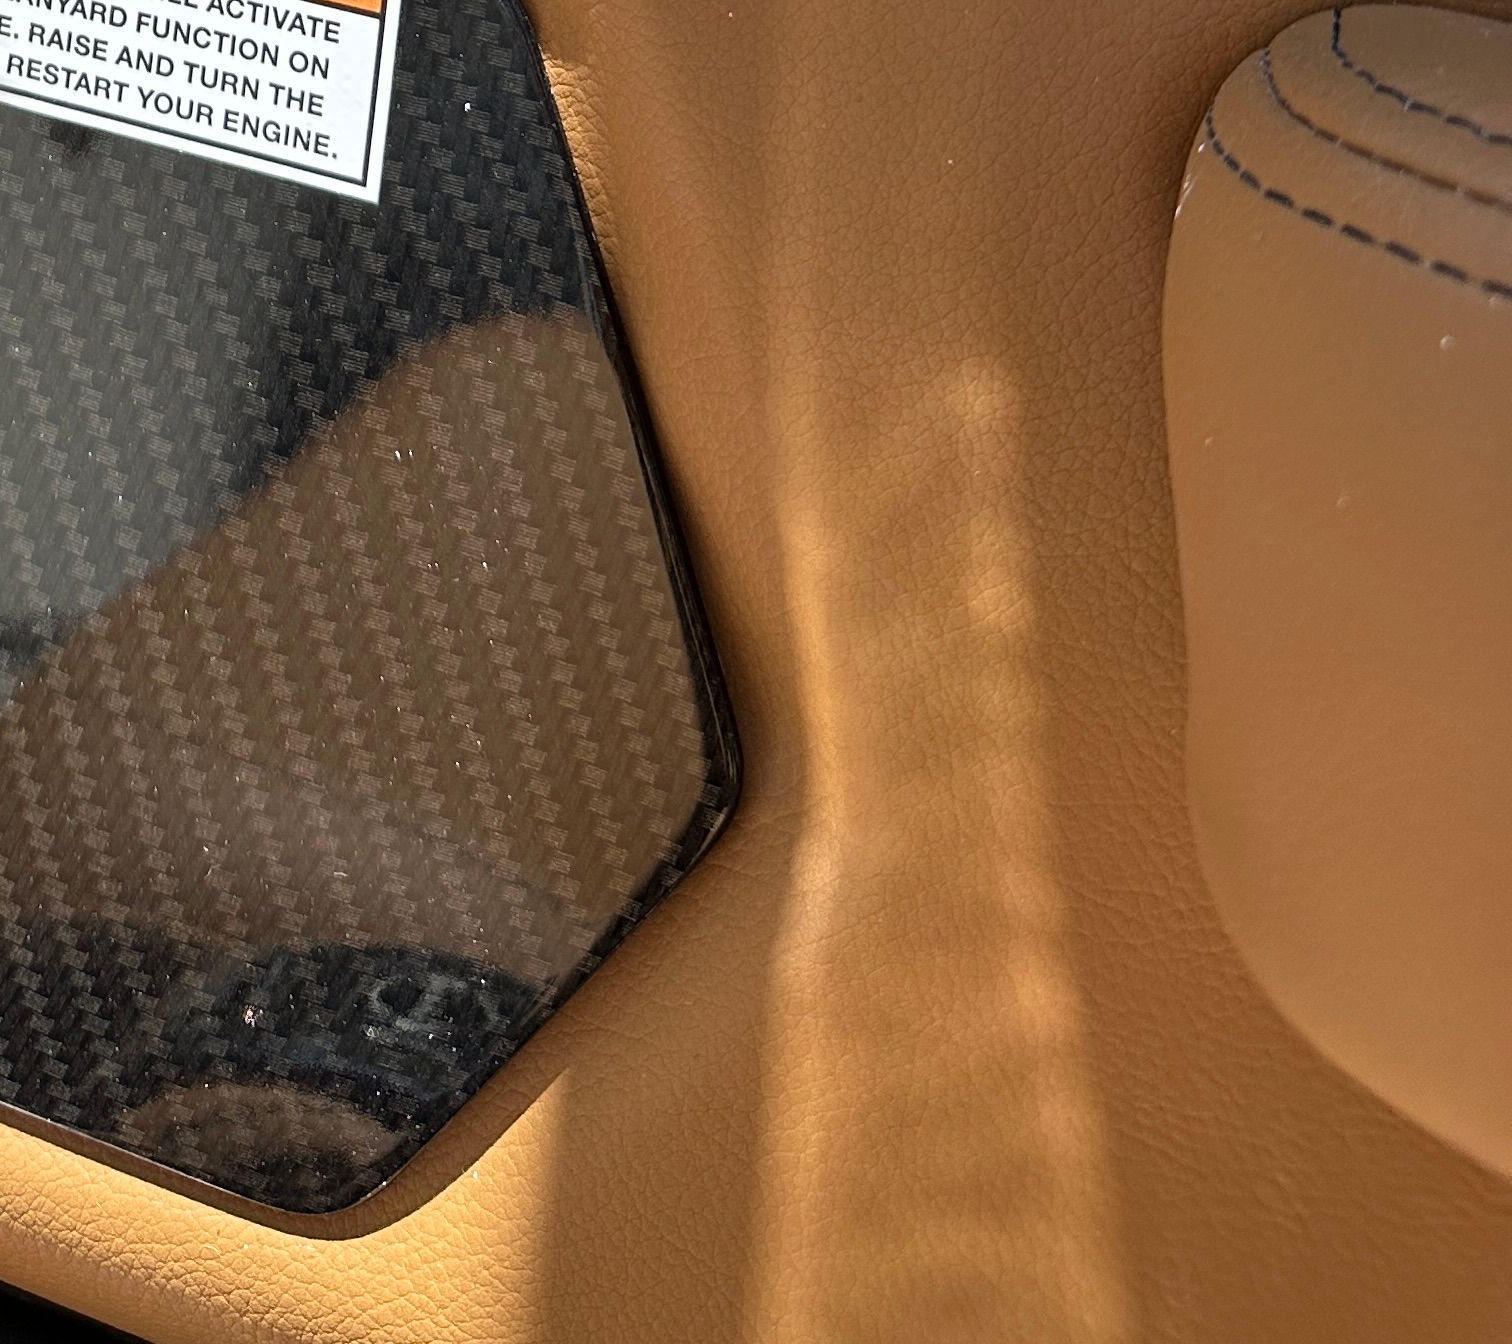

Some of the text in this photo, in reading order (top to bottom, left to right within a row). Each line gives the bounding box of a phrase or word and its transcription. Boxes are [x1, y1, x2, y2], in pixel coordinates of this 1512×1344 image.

[29, 23, 108, 61] RAISE
[115, 46, 174, 78] AND
[184, 60, 260, 99] TURN
[269, 82, 324, 116] THE
[136, 12, 280, 66] FUNCTION
[289, 50, 329, 79] ON
[6, 55, 129, 105] RESTART
[137, 89, 214, 128] YOUR
[223, 111, 338, 160] ENGINE.
